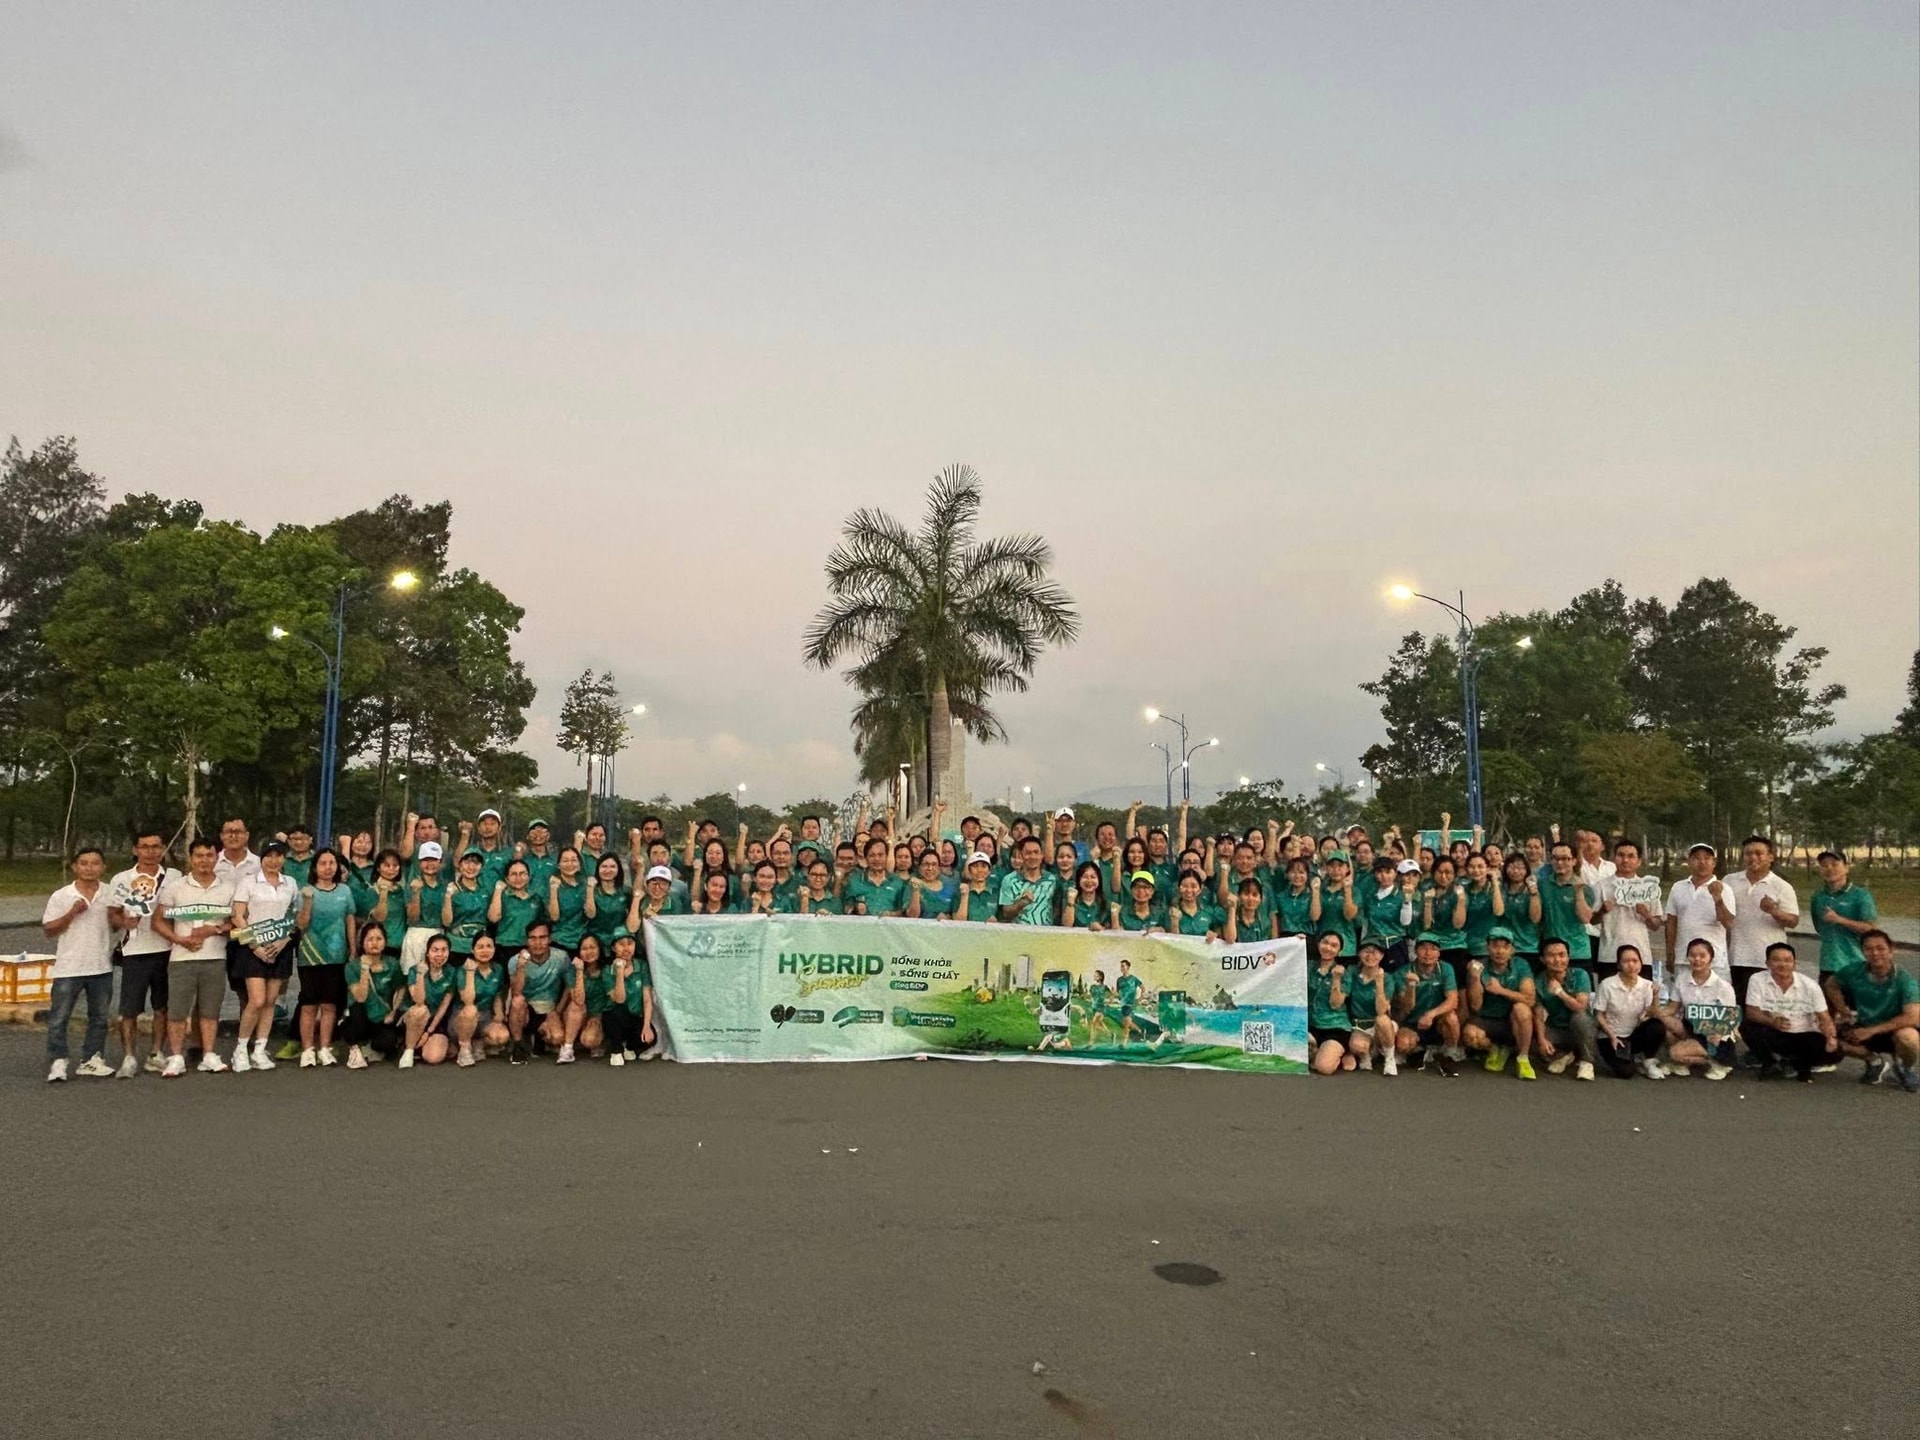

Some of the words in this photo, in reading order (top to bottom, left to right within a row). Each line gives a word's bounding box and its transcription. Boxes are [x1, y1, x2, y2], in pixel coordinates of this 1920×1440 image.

[256, 928, 284, 944] BIDV
[779, 953, 884, 975] HYBRID
[1222, 956, 1263, 970] BIDV
[1688, 1005, 1727, 1020] BIDV
